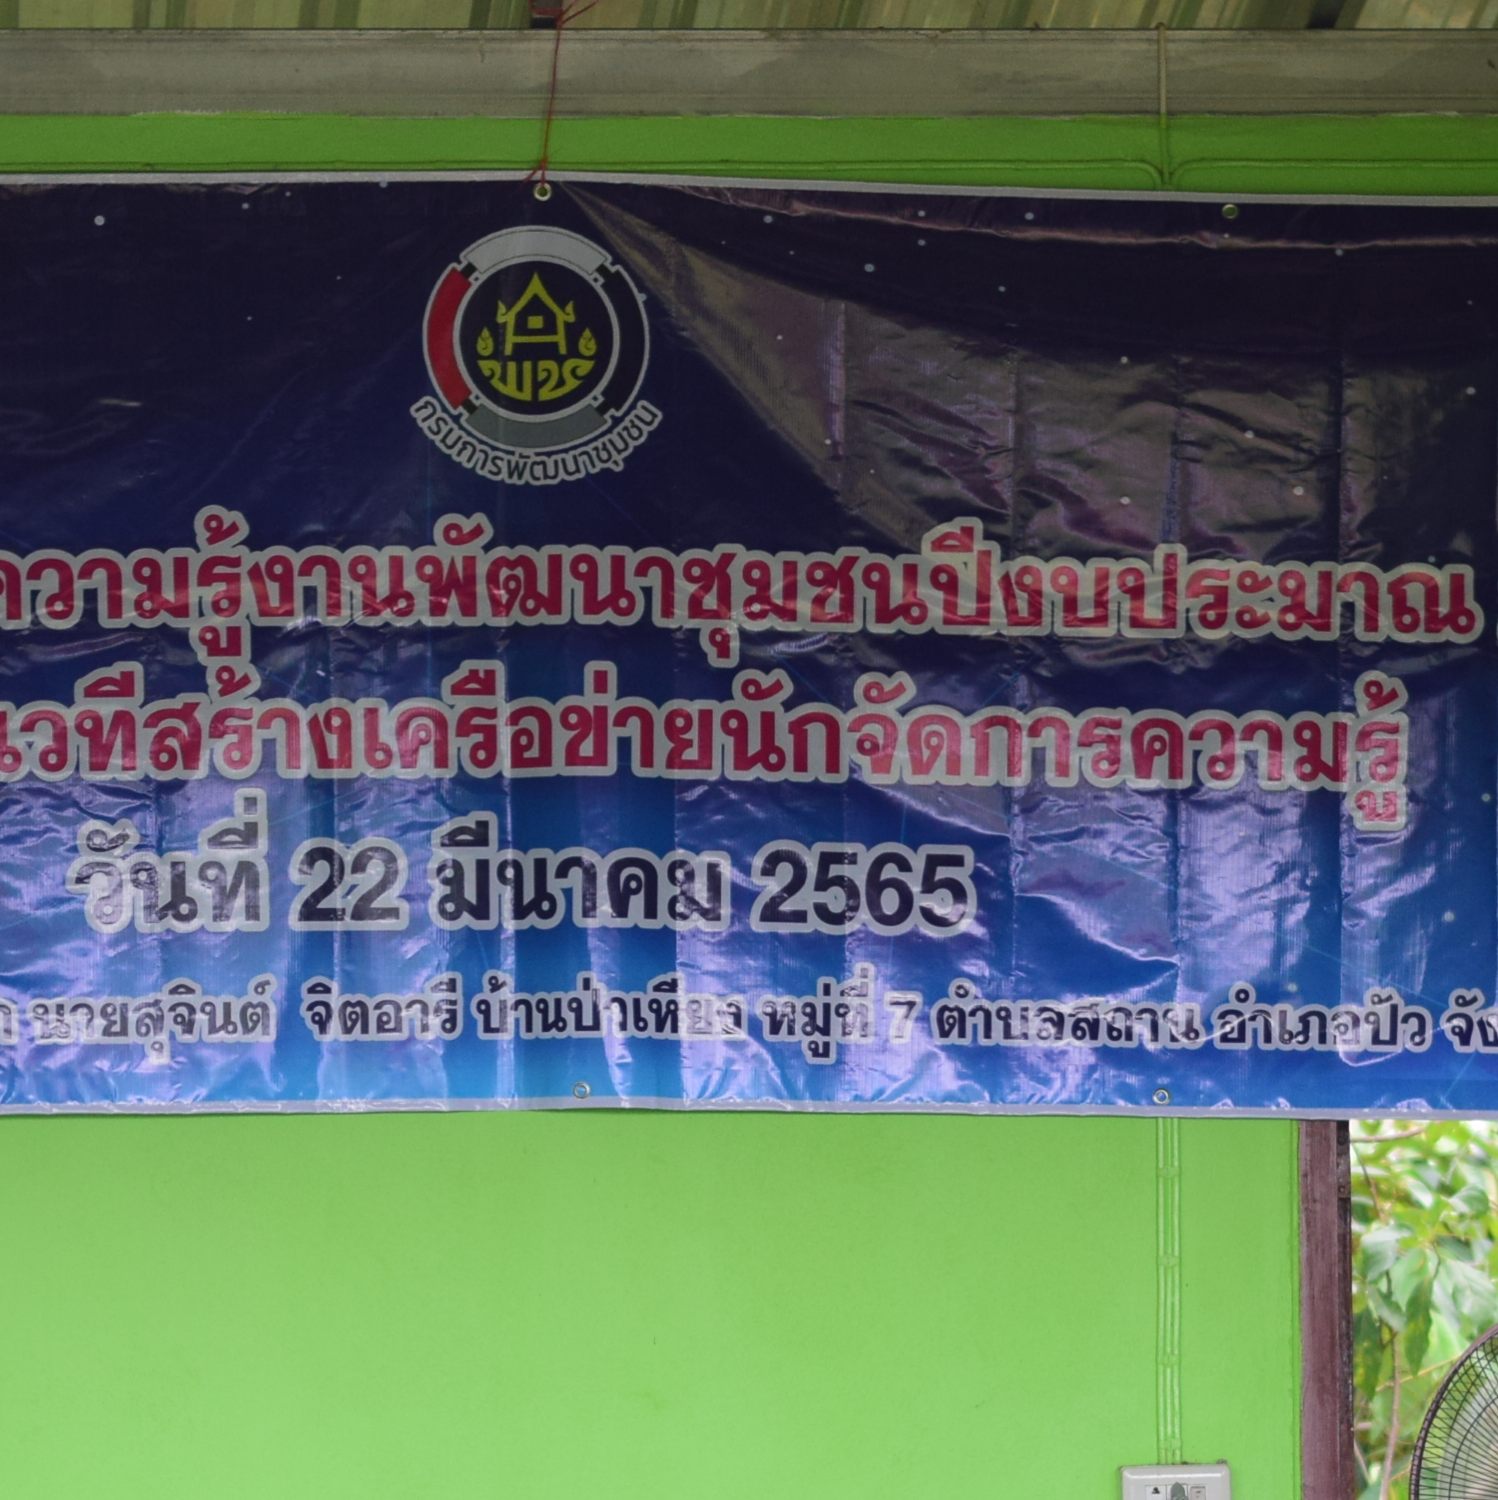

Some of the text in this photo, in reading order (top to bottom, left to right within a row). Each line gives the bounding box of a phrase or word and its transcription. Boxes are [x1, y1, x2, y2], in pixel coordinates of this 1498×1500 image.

[412, 396, 662, 484] กรมการพัฒนาชุมชน
[70, 790, 974, 936] วันที่ 22 มีนาคม 2565
[29, 974, 277, 1063] นายสุจินต์
[304, 975, 457, 1041] จิตอารี
[758, 963, 875, 1063] หมู่ที่
[887, 991, 922, 1042] 7
[933, 977, 1203, 1046] ตำบลสถาน
[1215, 982, 1431, 1050] อำเภอปัว
